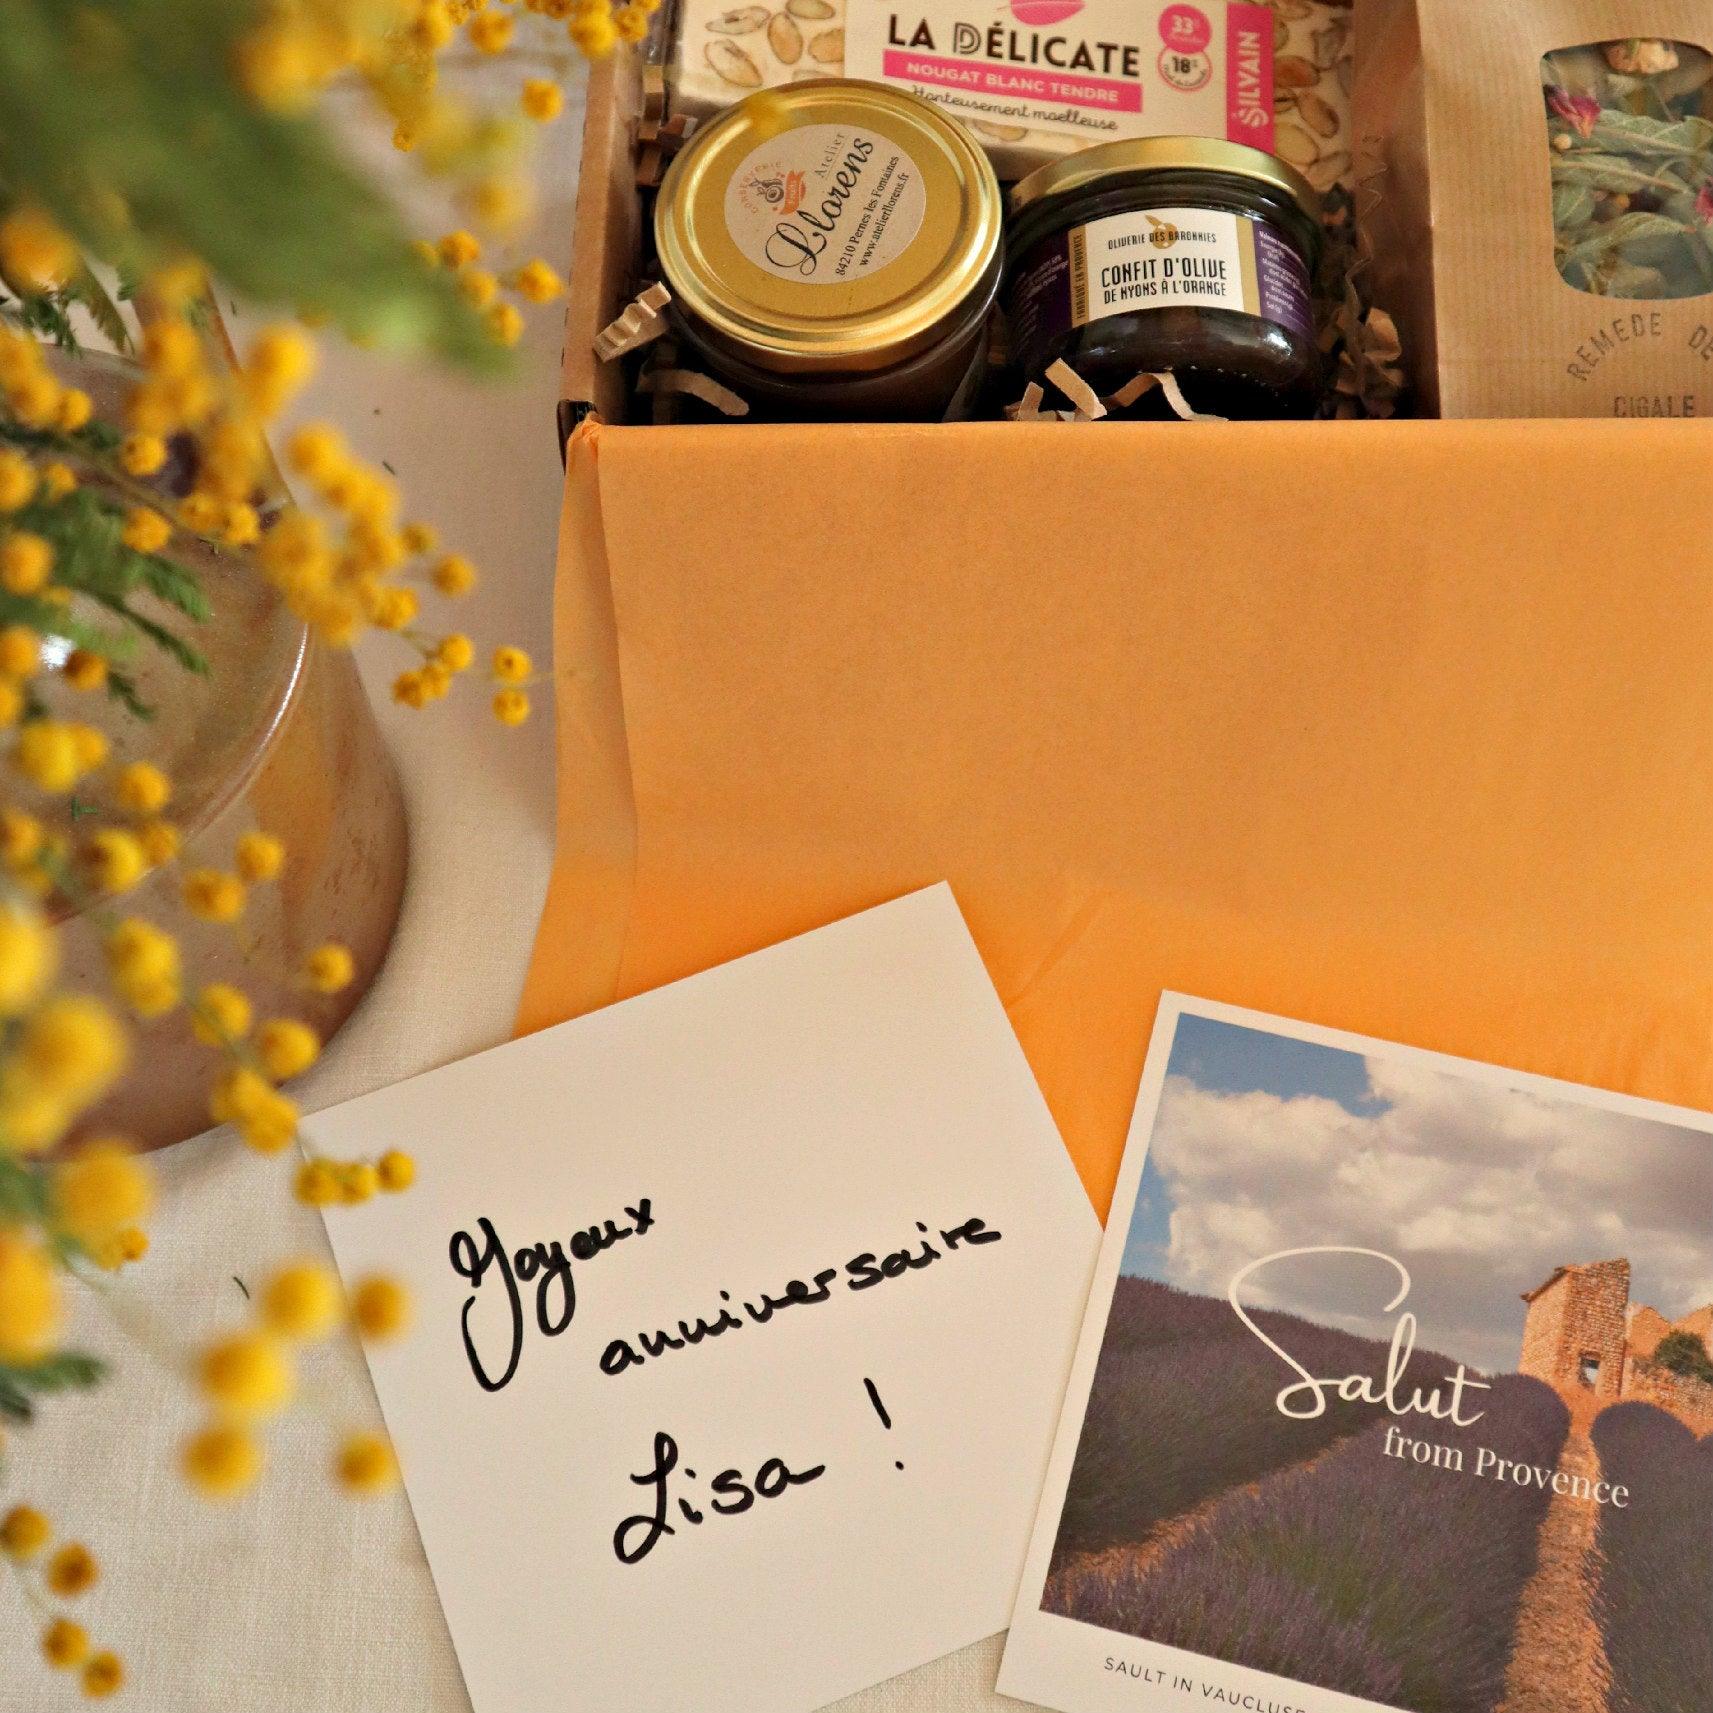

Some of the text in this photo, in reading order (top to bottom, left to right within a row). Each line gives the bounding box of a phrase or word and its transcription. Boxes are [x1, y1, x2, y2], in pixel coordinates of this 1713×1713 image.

[888, 14, 1140, 78] LA DÉLICATE
[1232, 31, 1270, 128] SILVAIN
[906, 61, 1119, 103] NOUGAT BLANC TENDRE
[912, 84, 1119, 132] Honteusement moelleuse
[814, 133, 845, 179] Atelier
[765, 137, 873, 276] Llorens
[835, 156, 899, 276] 84210 Pernes les Fontaines
[859, 172, 910, 266] www.atelierllorens.fr
[1149, 232, 1166, 243] DES
[1168, 230, 1217, 244] BARONNIES
[1101, 258, 1157, 288] CONFIT
[1104, 278, 1227, 305] DE NYONS À L'ORANGE
[1567, 312, 1661, 382] REMEDE
[1614, 395, 1696, 418] CIGALE
[600, 1218, 1002, 1375] anniversaire
[1228, 1246, 1491, 1428] Salut
[613, 1431, 825, 1565] Lisa
[1382, 1426, 1630, 1509] from Provence
[1104, 1656, 1305, 1713] SAULT IN VAUCLUS
